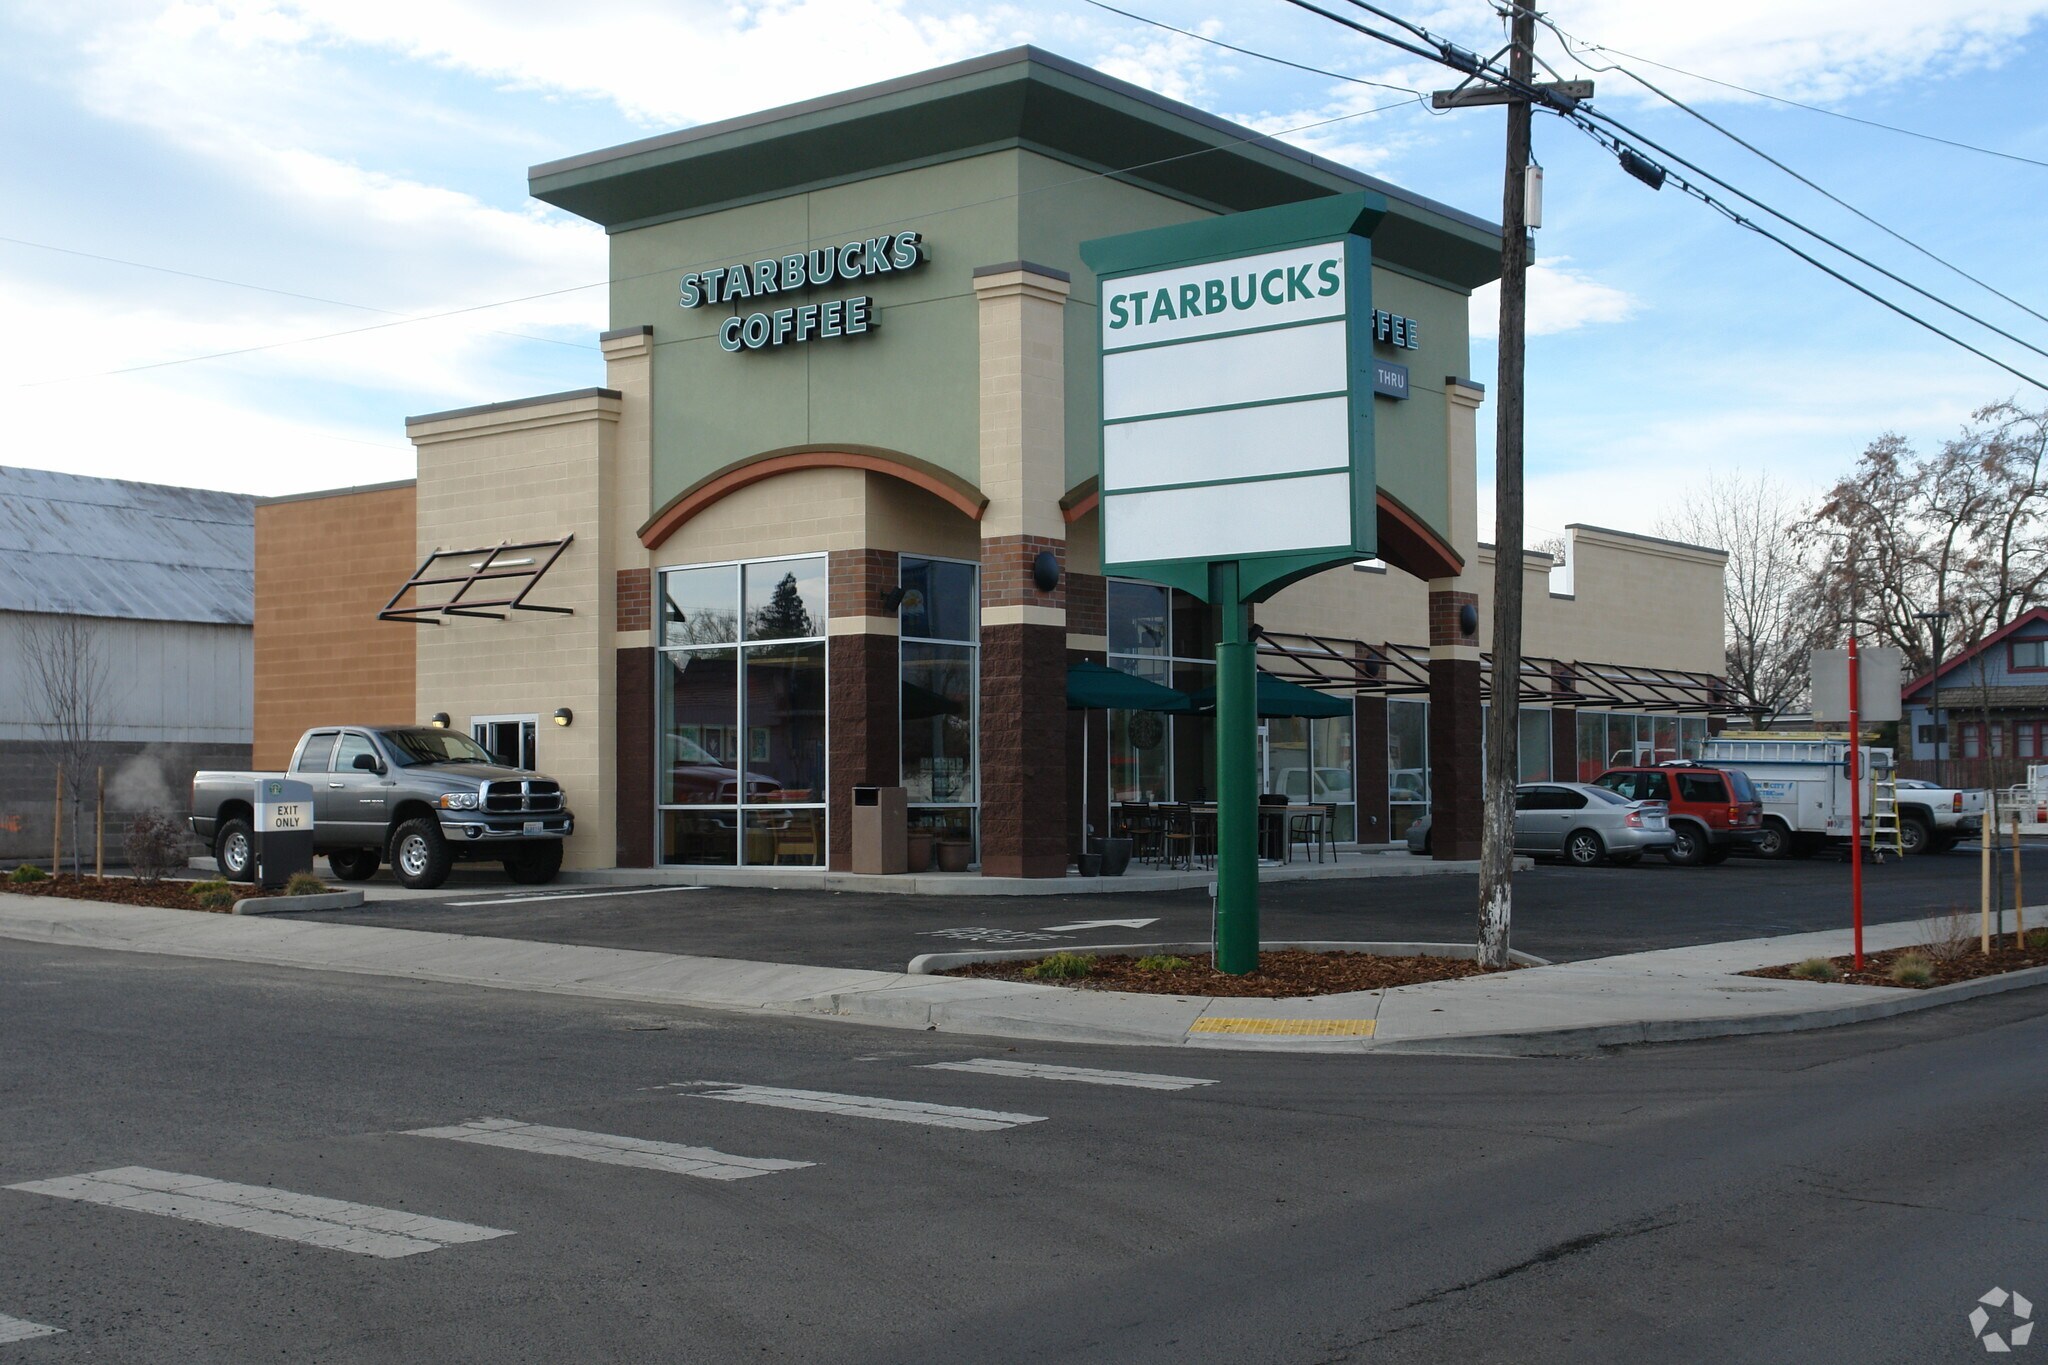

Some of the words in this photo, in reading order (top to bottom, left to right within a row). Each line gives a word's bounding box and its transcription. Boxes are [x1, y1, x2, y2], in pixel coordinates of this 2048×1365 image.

[679, 231, 919, 308] STARBUCKS
[1109, 259, 1340, 330] STARBUCKS
[718, 296, 869, 353] COFFEE
[1378, 369, 1404, 388] THRU
[275, 817, 300, 828] ONLY
[277, 805, 299, 816] EXIT
